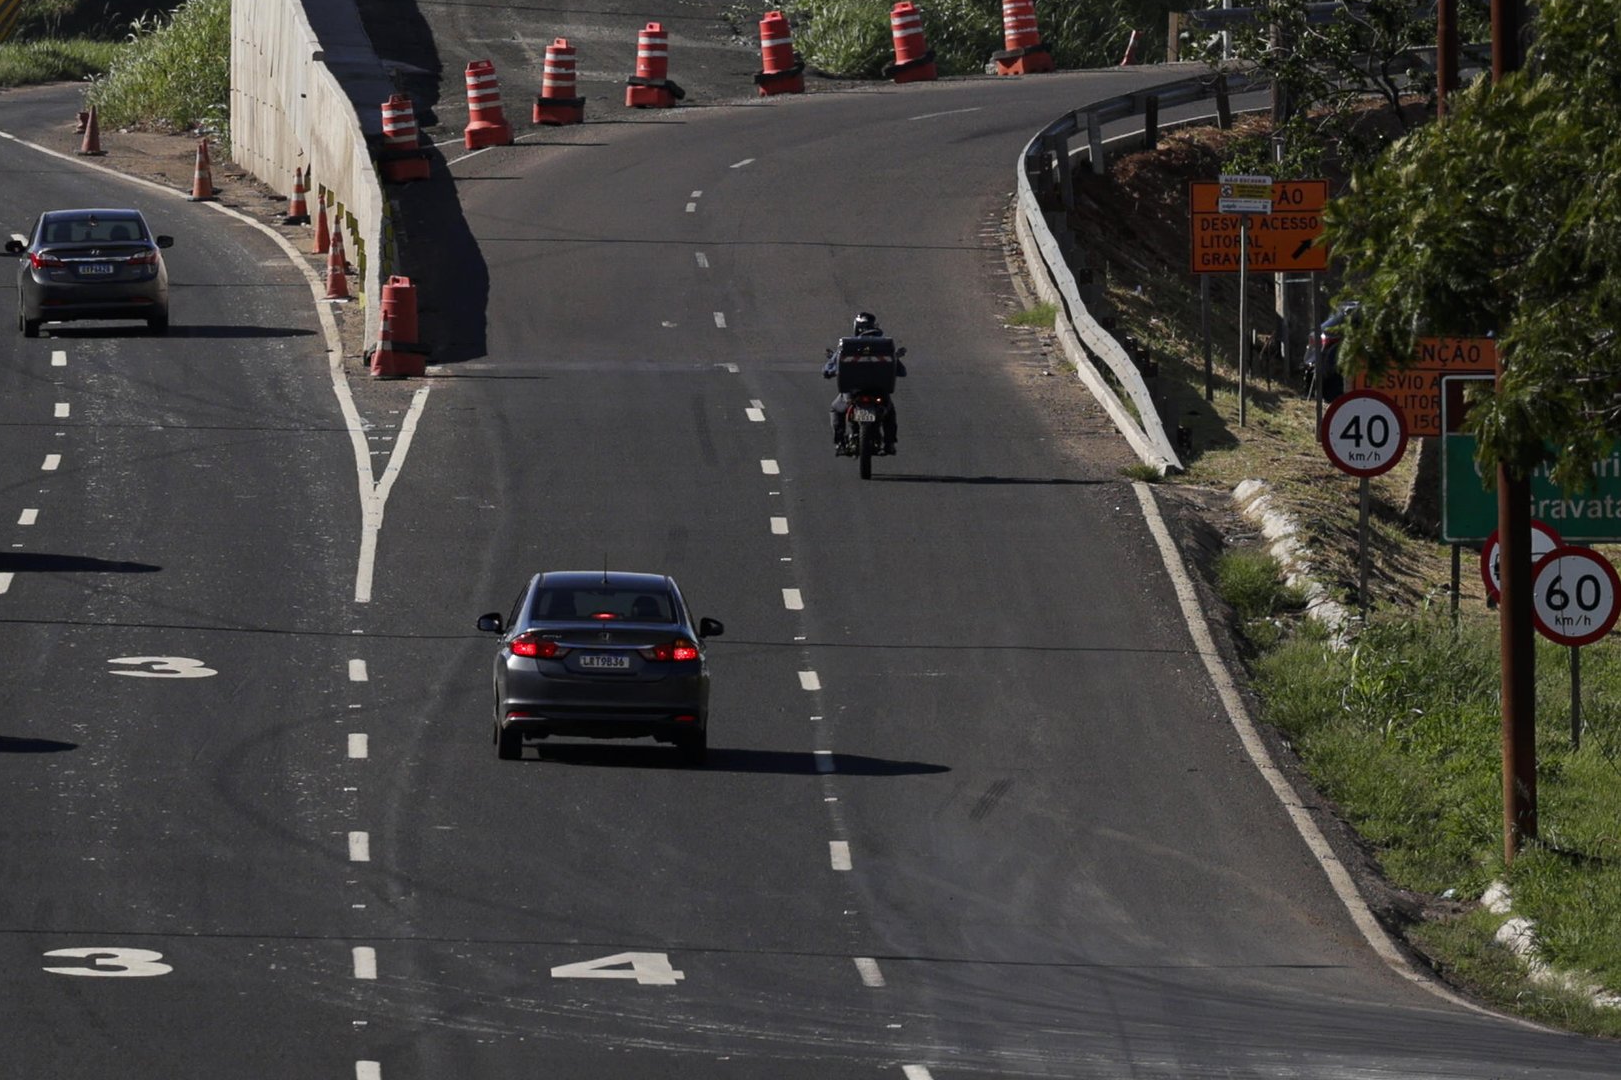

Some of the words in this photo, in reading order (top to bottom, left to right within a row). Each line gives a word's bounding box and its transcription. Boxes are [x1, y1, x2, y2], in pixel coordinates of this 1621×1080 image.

[1260, 216, 1318, 230] ACESSO
[1339, 414, 1390, 449] 40
[1348, 451, 1381, 462] km/h
[1545, 574, 1601, 611] 60
[1554, 615, 1591, 626] km/h
[107, 656, 218, 678] 3
[41, 947, 174, 977] 3
[550, 951, 686, 985] 4
